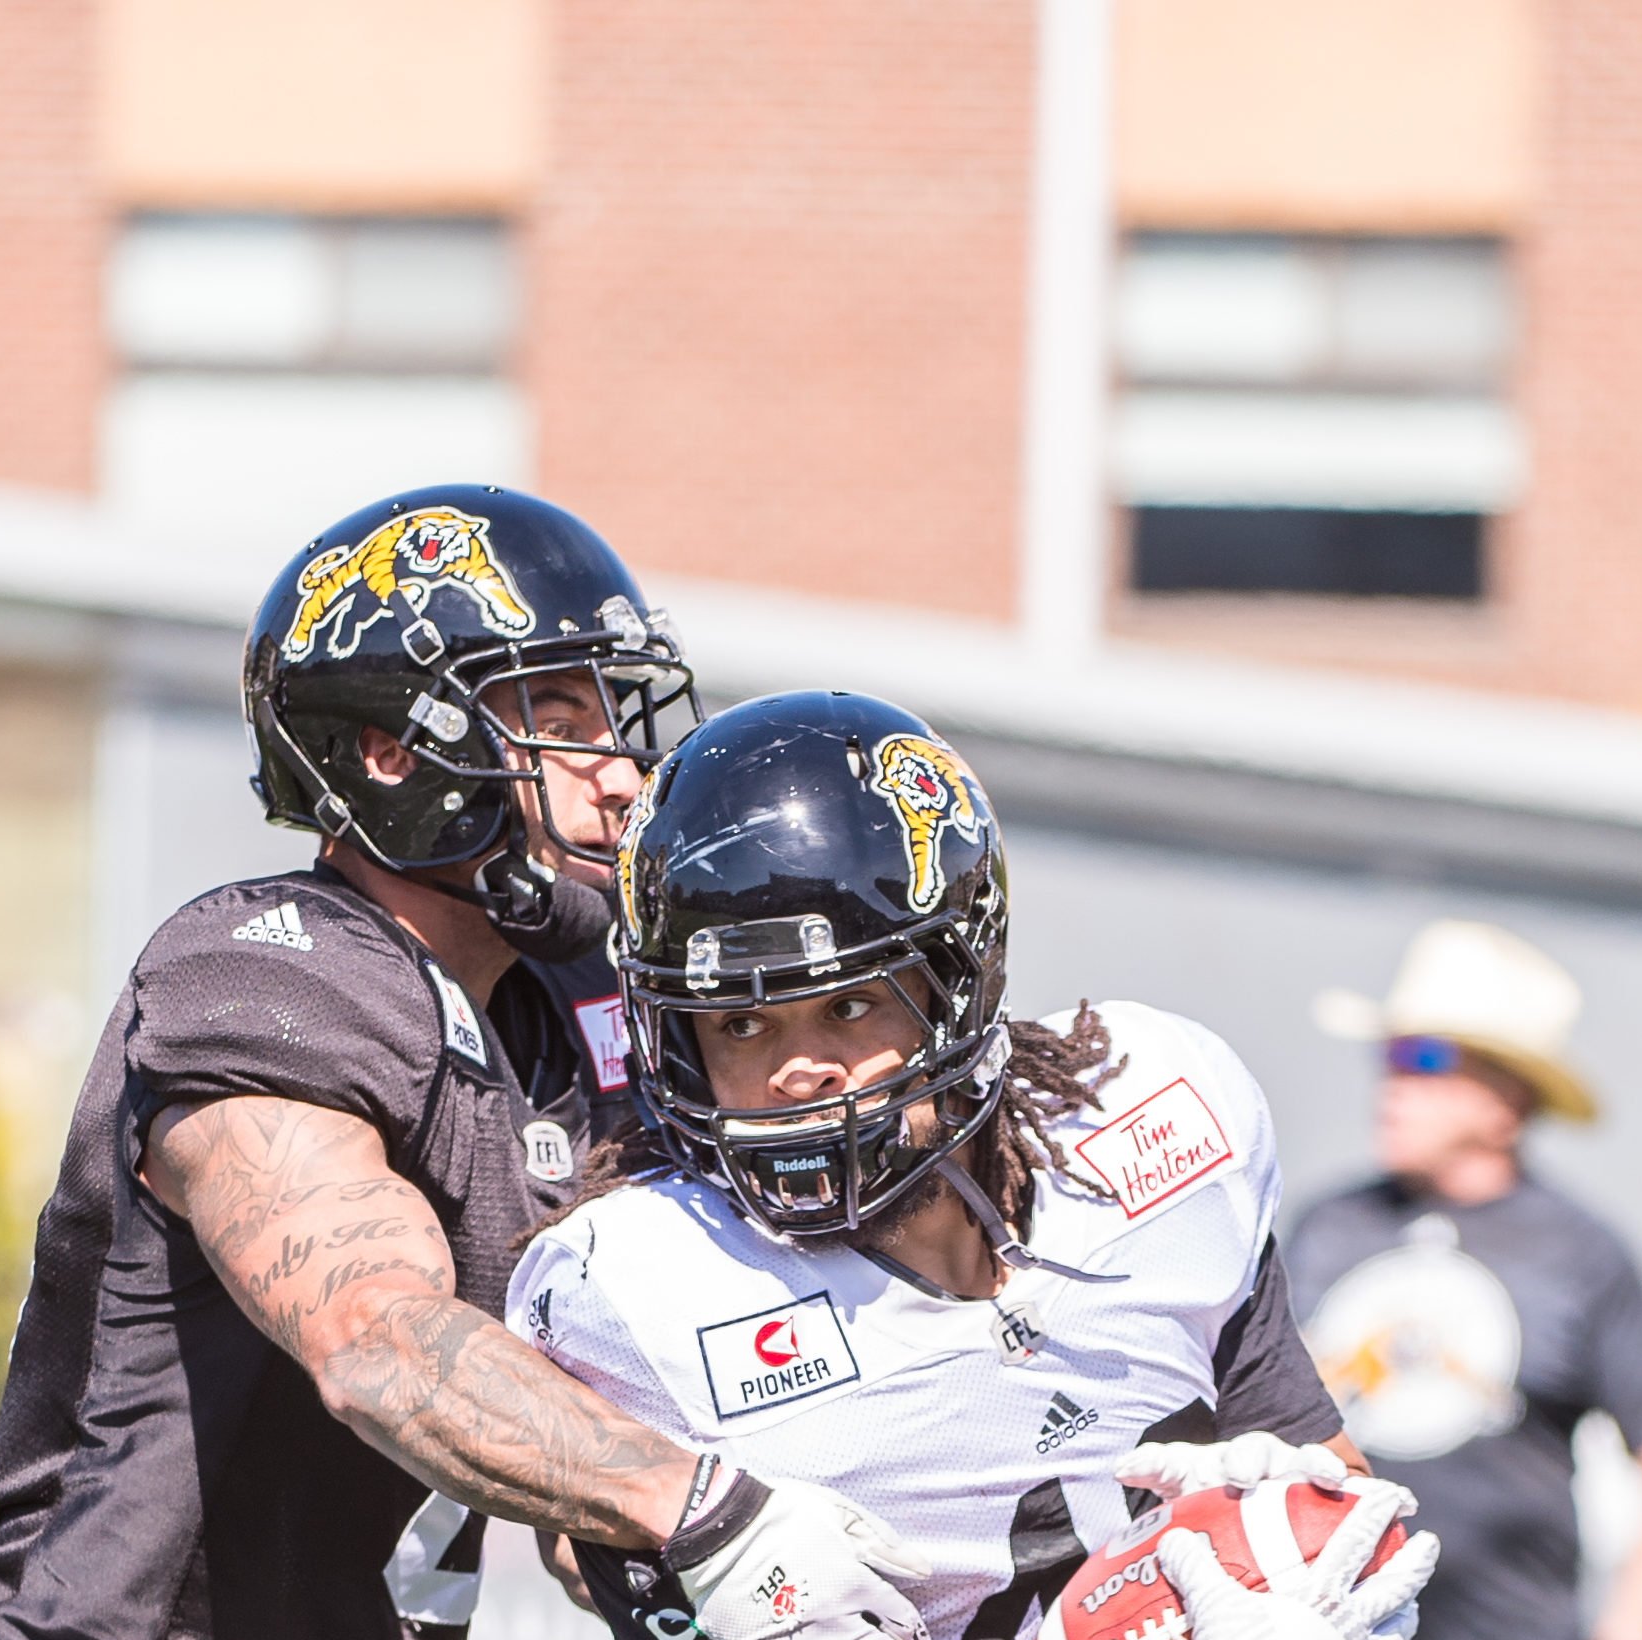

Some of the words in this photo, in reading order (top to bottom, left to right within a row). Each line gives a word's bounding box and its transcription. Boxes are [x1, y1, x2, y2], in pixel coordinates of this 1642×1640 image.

[232, 925, 314, 952] adidas
[1120, 1113, 1179, 1157] Tim
[1122, 1136, 1220, 1204] Hortons
[1002, 1316, 1040, 1353] CFL
[740, 1357, 832, 1404] PIONEER
[1036, 1409, 1099, 1455] adidas
[757, 1565, 787, 1600] CFL
